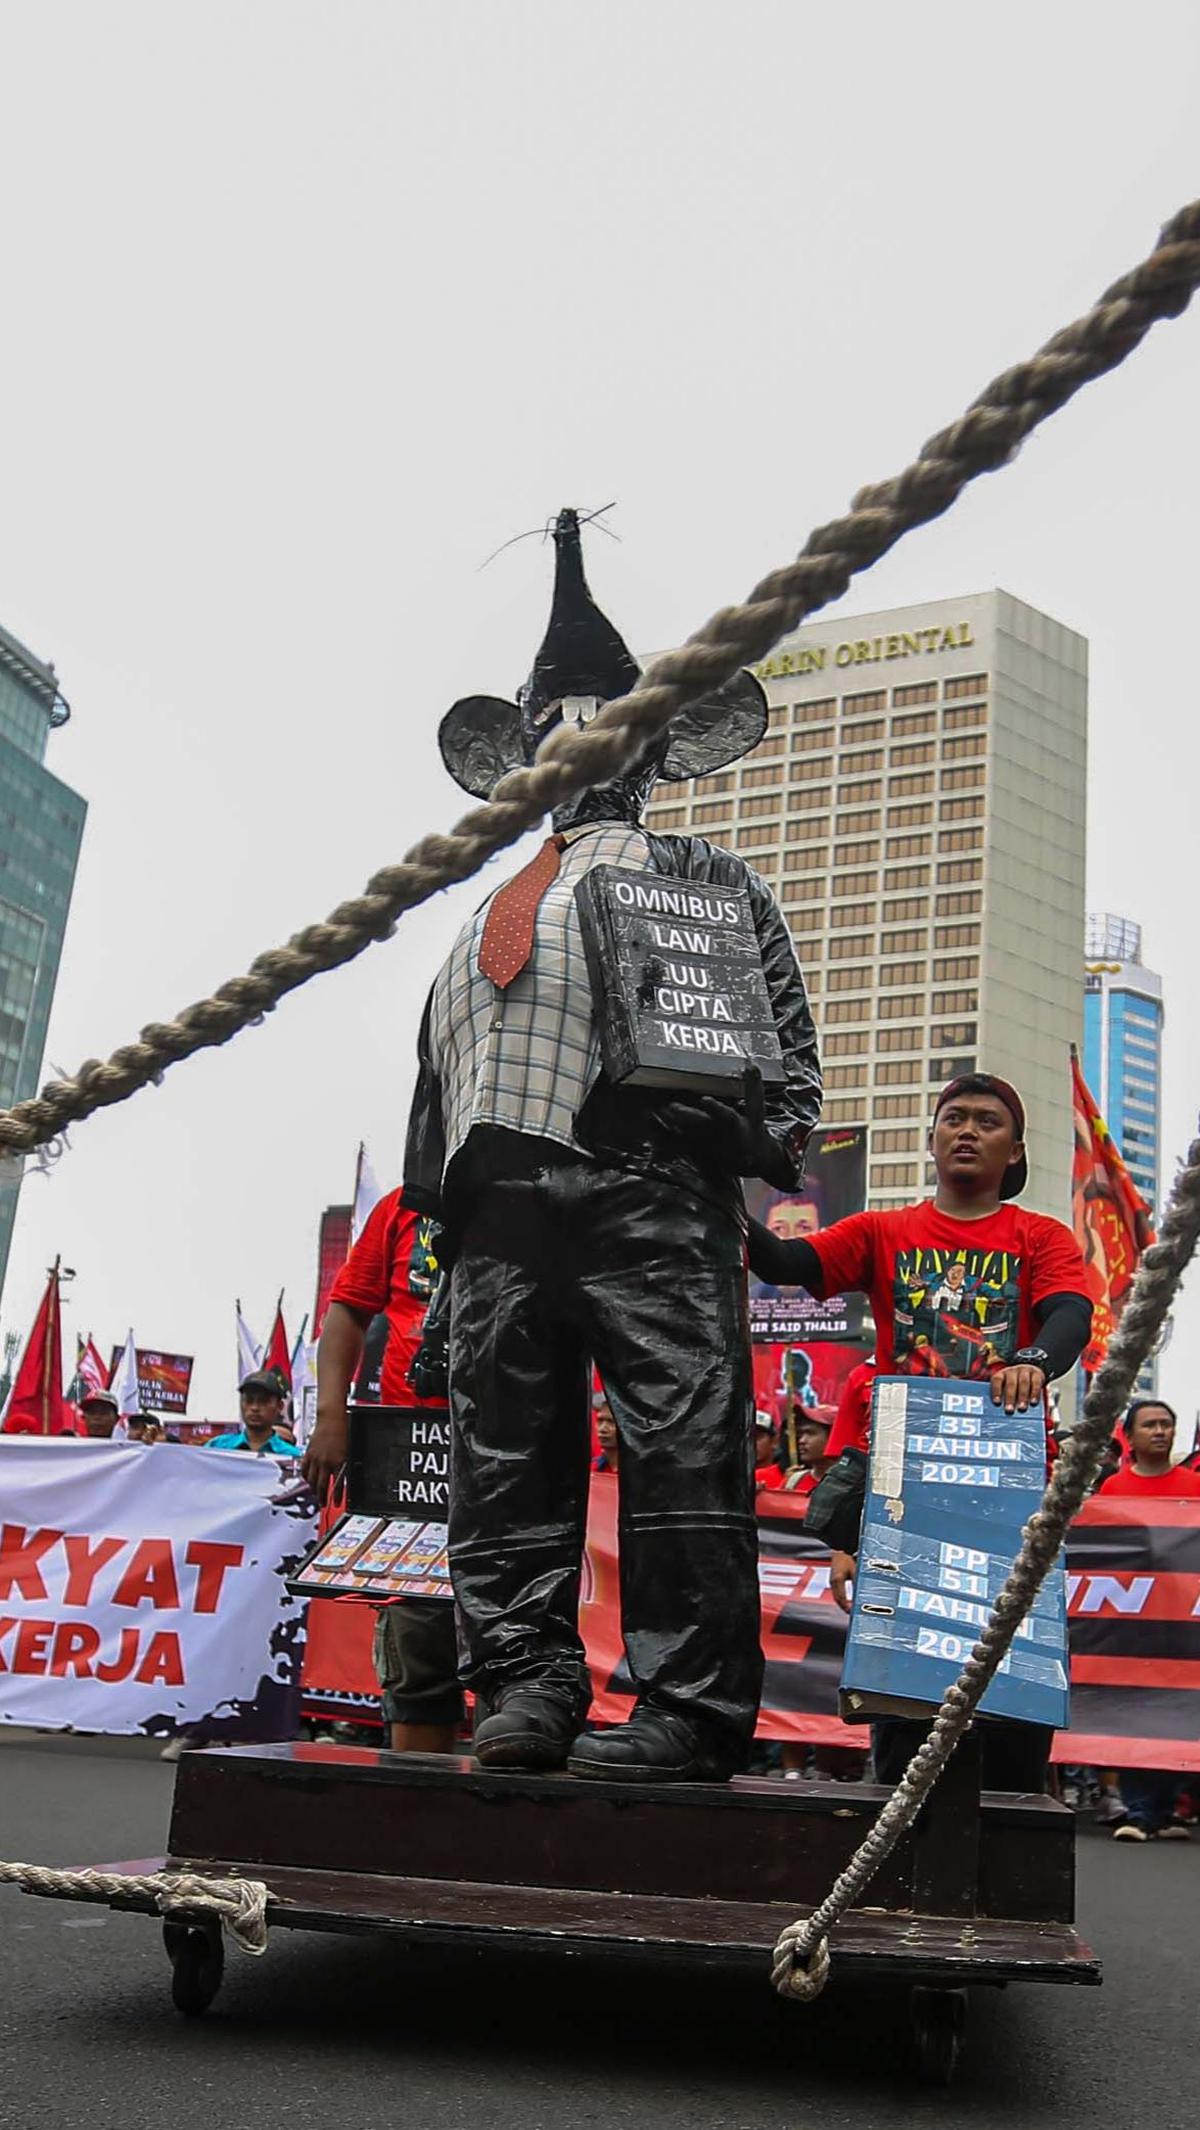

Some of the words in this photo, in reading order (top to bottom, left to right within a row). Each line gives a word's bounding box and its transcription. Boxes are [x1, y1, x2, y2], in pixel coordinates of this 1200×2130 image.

[756, 648, 826, 678] ARIN
[834, 621, 975, 668] ORIENTAL
[615, 882, 739, 924] OMNIBUS
[654, 926, 711, 955] LAW
[669, 963, 708, 988] UU
[658, 988, 731, 1021] CIPTA
[663, 1022, 741, 1056] KERJA
[771, 1322, 801, 1333] SAID
[803, 1320, 848, 1332] THALIB
[946, 1395, 983, 1413] PP
[943, 1416, 977, 1436] 35
[908, 1434, 1018, 1460] TAHUN
[922, 1462, 995, 1487] 2021
[0, 1524, 245, 1614] KYAT
[945, 1548, 988, 1571] PP
[942, 1567, 984, 1596] 51
